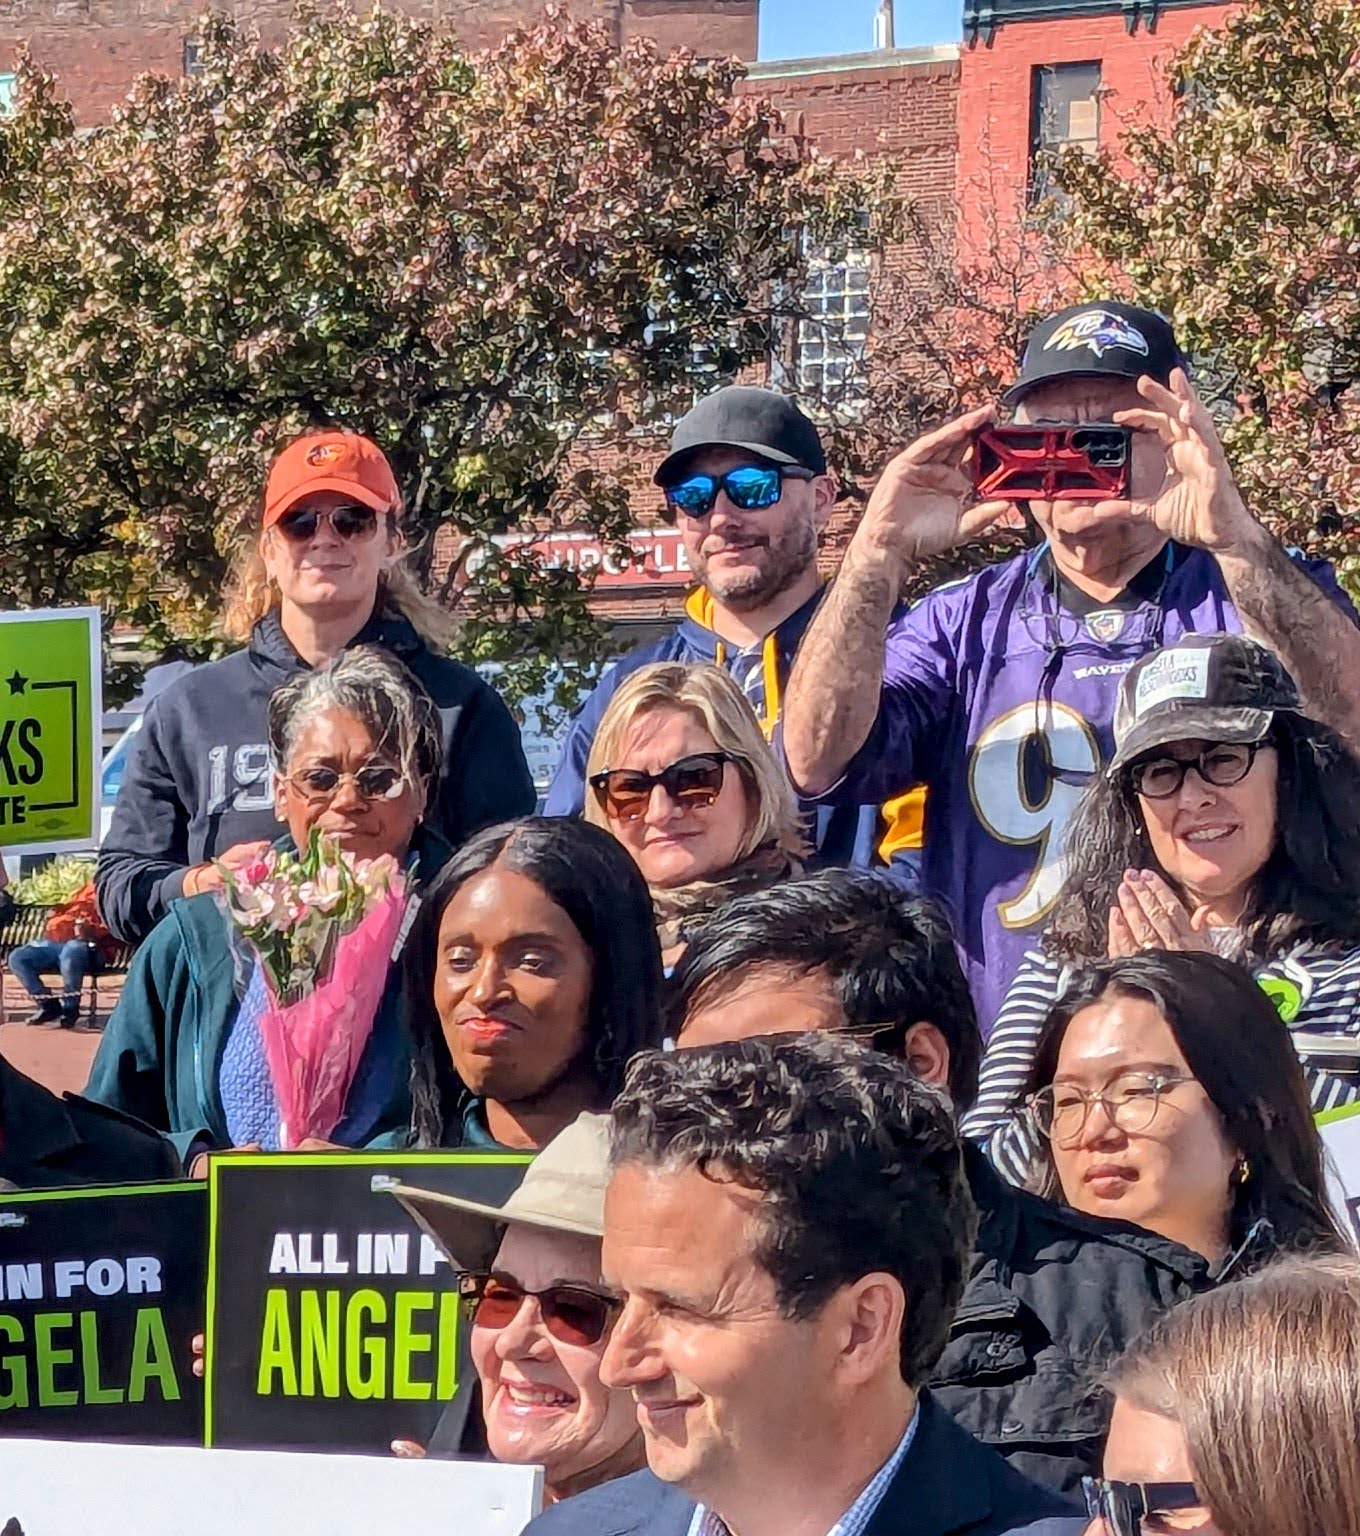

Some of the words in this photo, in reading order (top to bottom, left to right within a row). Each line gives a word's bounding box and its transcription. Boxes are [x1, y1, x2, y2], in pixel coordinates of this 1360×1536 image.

[1073, 659, 1135, 679] RAVEN
[269, 1233, 349, 1274] ALL
[357, 1233, 409, 1274] IN
[54, 1256, 162, 1298] FOR
[257, 1289, 460, 1400] ANGEL
